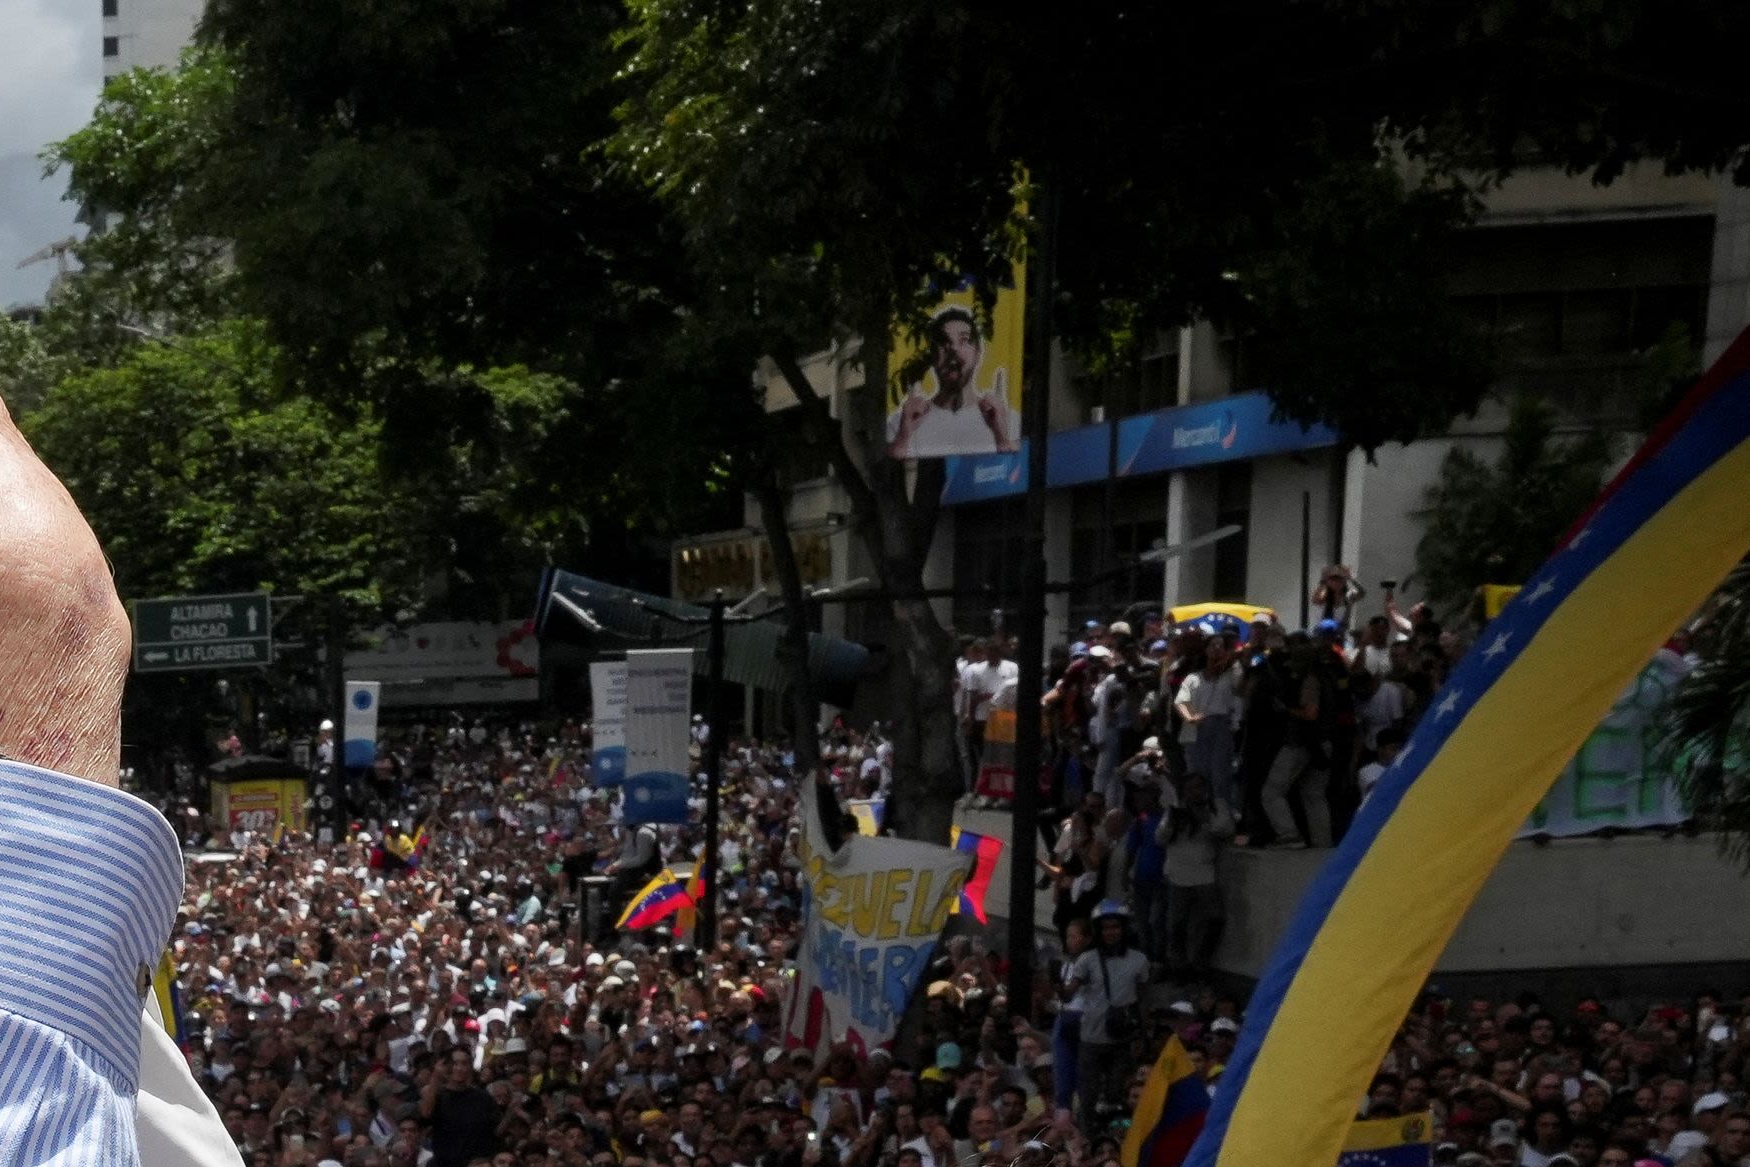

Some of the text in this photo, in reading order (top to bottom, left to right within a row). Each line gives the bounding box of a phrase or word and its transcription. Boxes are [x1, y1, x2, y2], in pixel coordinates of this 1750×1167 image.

[170, 603, 234, 622] ALTAMIRA
[170, 622, 229, 640] CHACAO
[174, 643, 257, 663] LA FLORESTA
